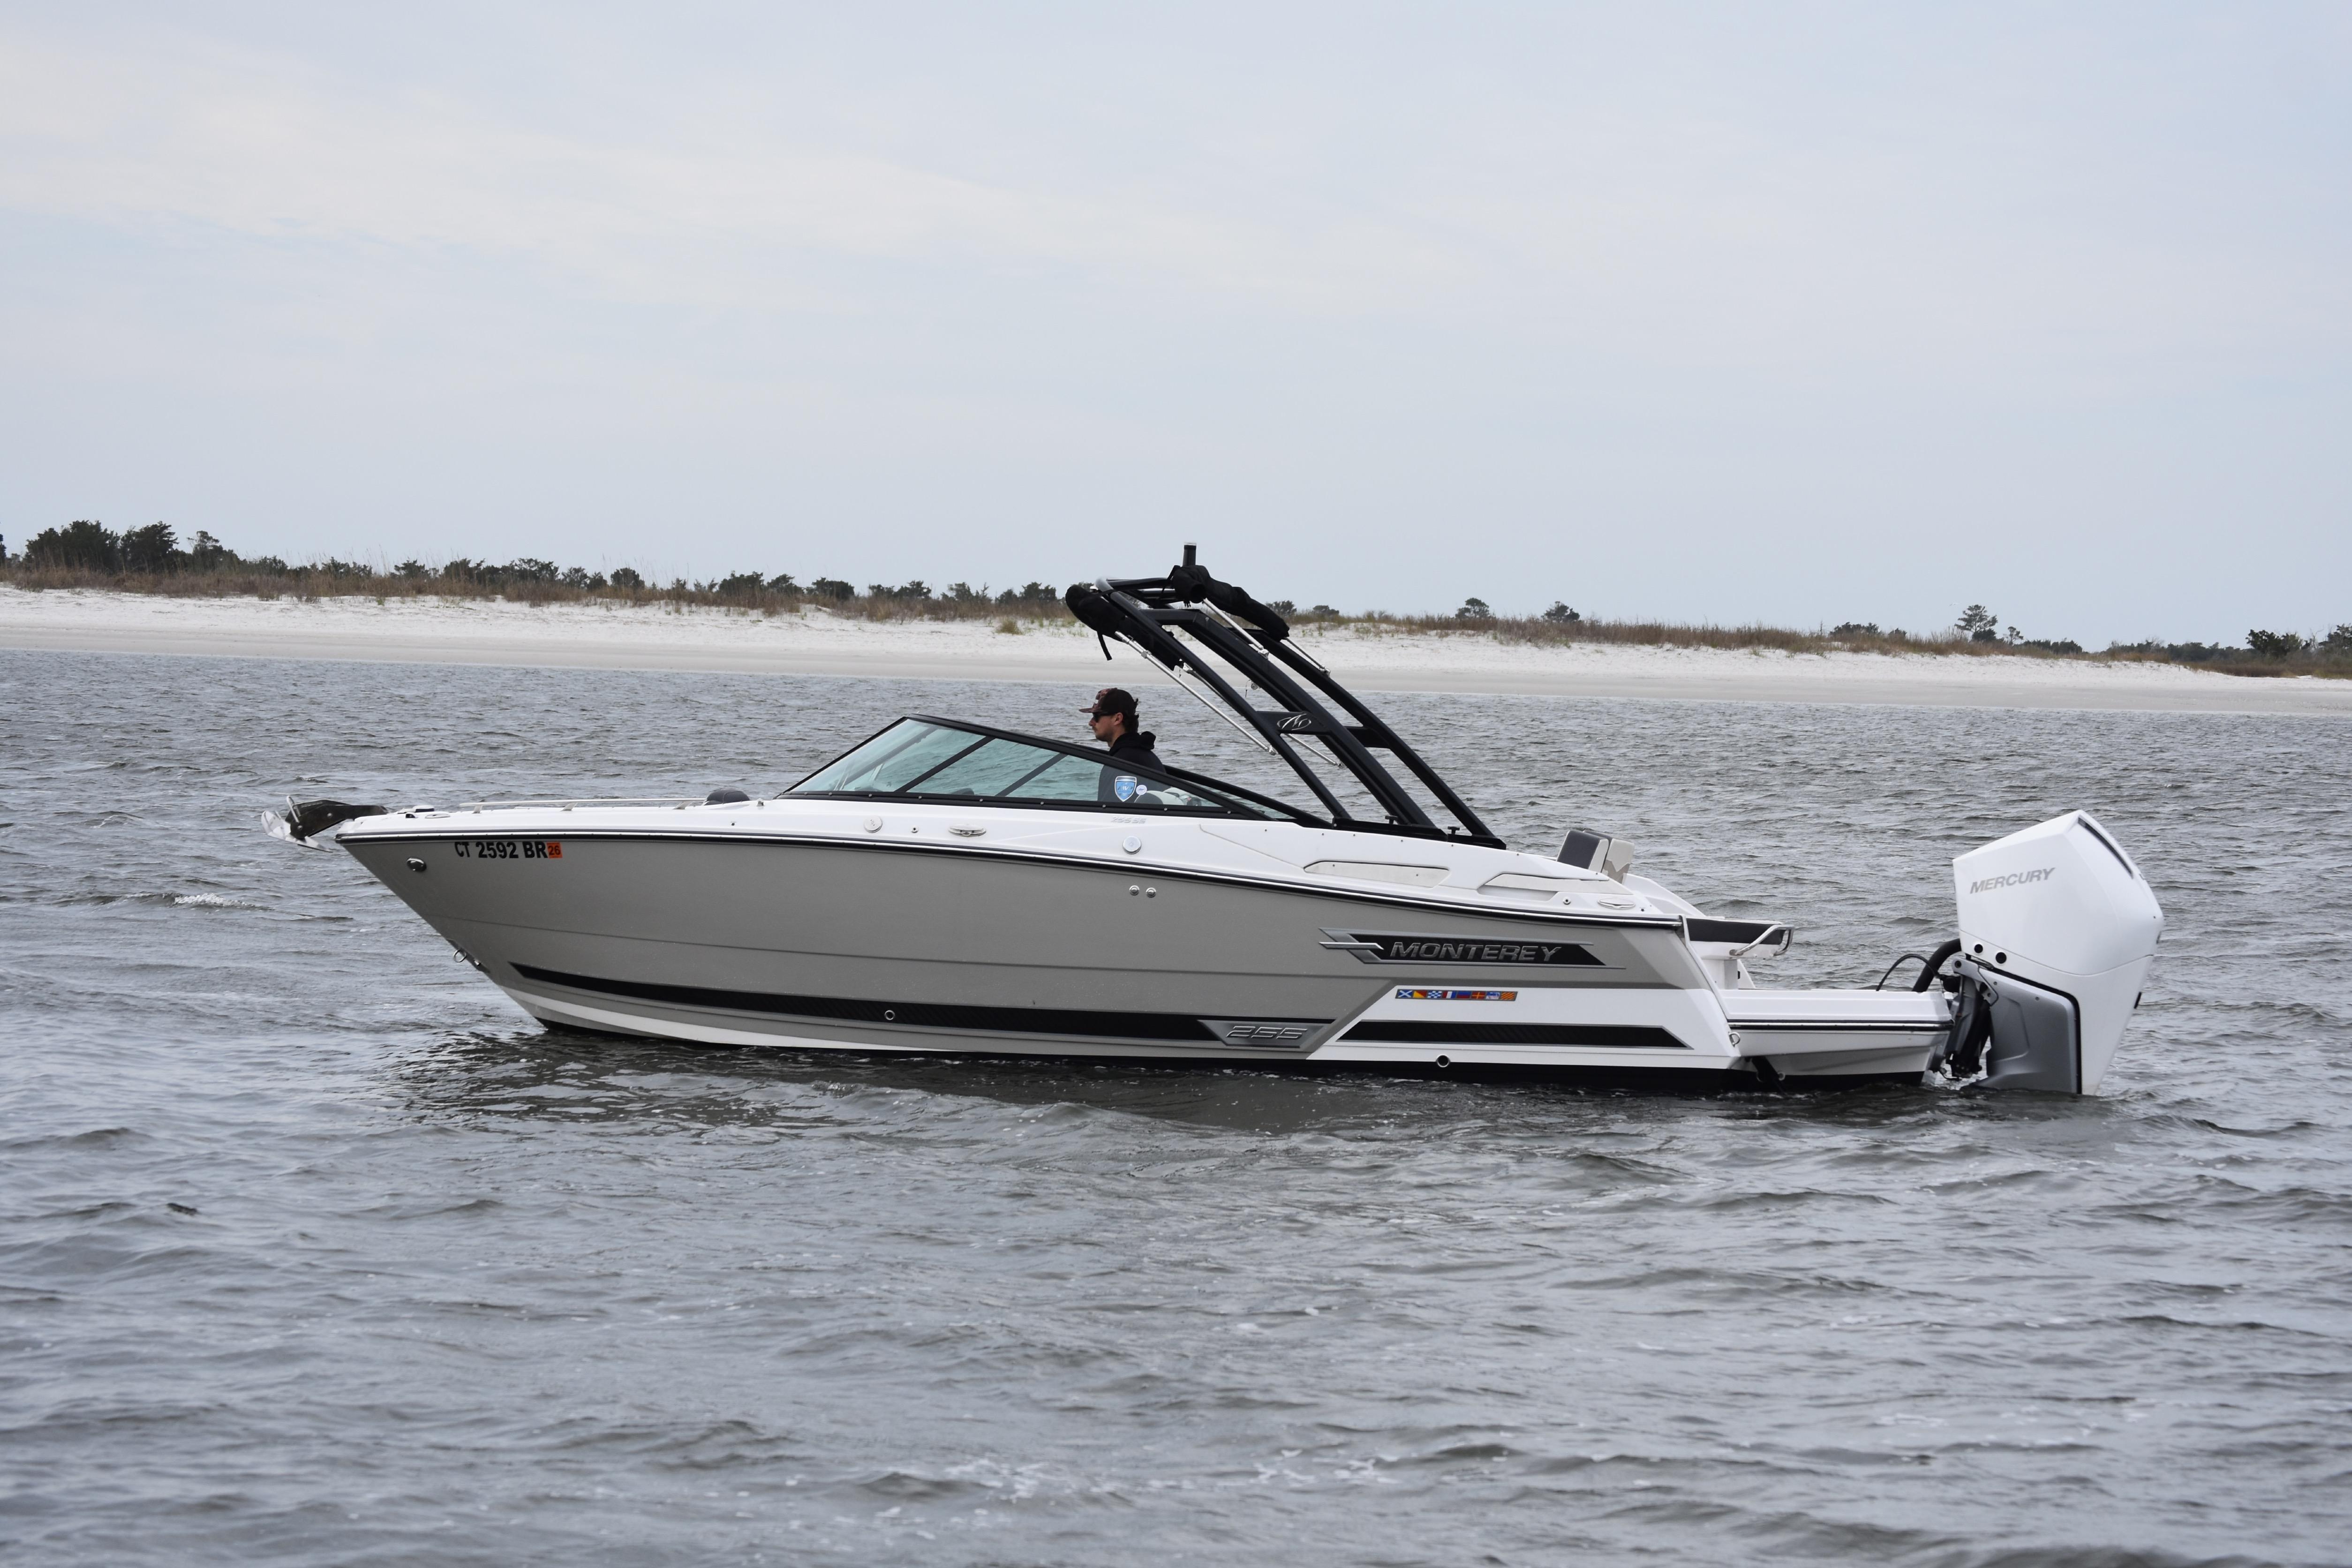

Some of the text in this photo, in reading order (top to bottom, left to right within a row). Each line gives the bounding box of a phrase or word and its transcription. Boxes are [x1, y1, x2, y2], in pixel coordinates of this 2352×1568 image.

[454, 841, 548, 859] CT 2592 BR
[547, 845, 561, 855] 26
[1970, 867, 2056, 894] MERCURY
[1390, 942, 1562, 962] MONTEREY
[1226, 1025, 1308, 1040] 255
